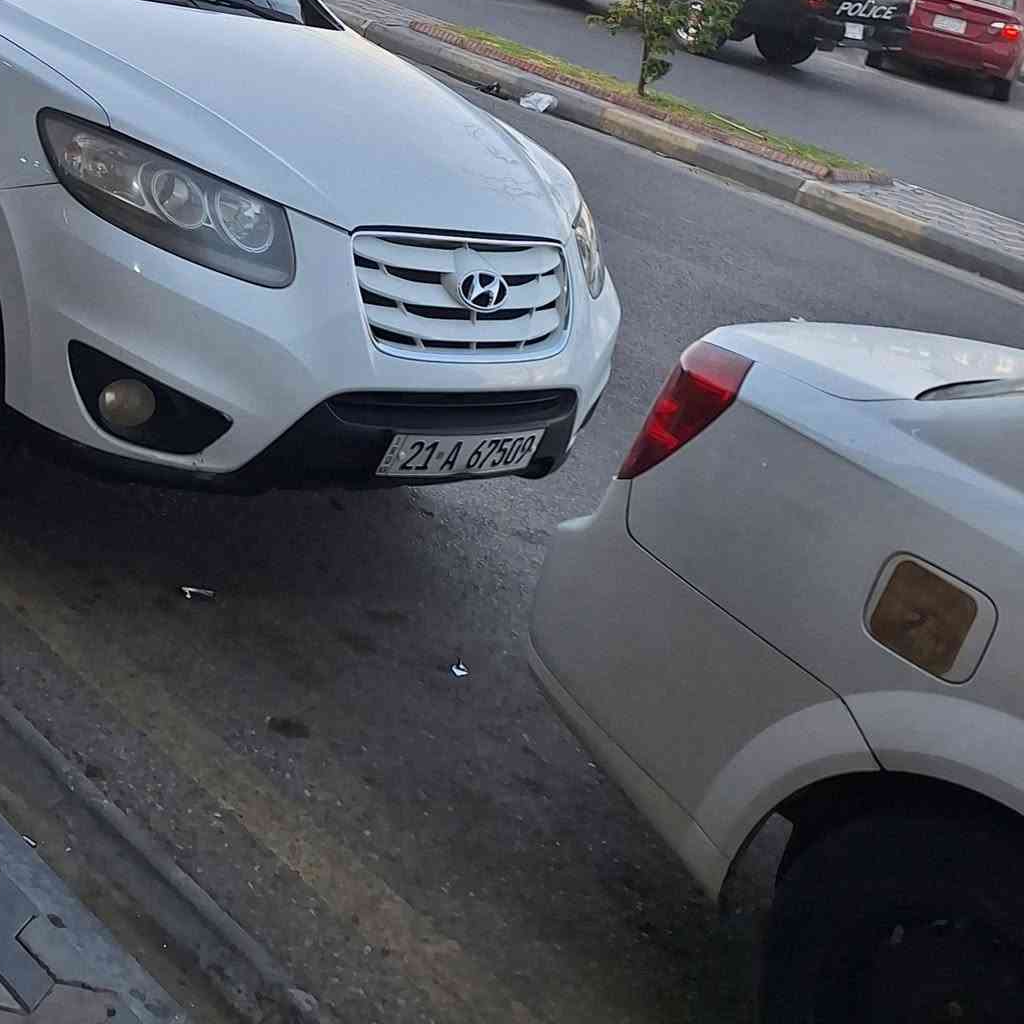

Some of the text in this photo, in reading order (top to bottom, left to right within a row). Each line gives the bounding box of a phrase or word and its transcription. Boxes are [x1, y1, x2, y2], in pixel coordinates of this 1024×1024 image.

[398, 441, 440, 471] 21
[440, 441, 464, 471] A
[466, 435, 537, 470] 67509
